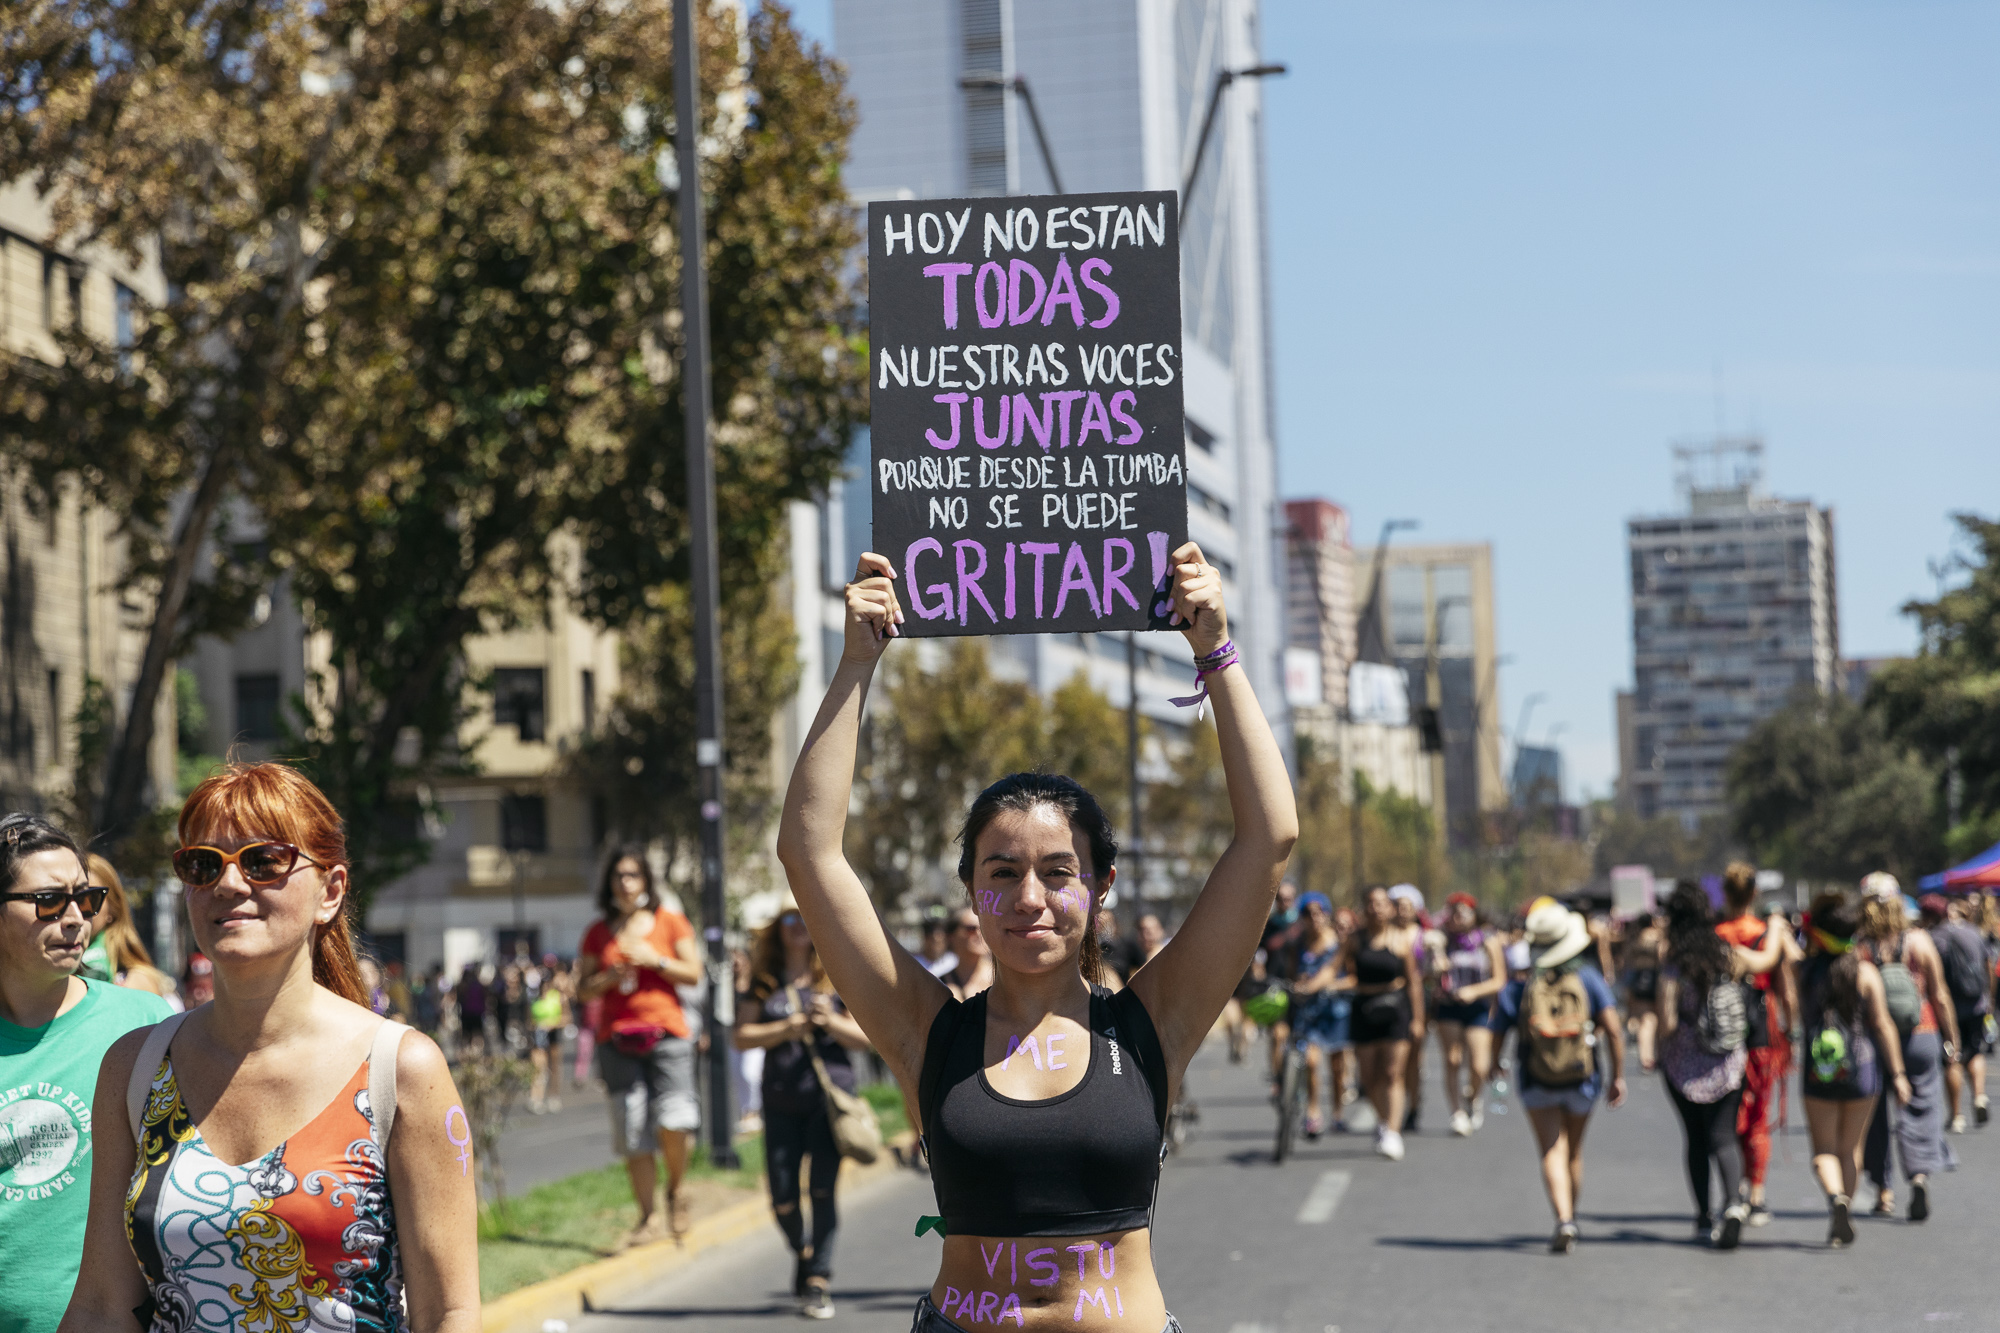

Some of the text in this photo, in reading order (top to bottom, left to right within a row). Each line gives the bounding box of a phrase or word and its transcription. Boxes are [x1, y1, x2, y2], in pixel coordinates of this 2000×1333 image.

[884, 201, 1165, 258] HOY NO ESTAN
[923, 252, 1121, 330] TODAS
[878, 343, 1175, 391] NUESTRAS VOCES
[925, 390, 1144, 453] JUNTAS
[878, 453, 1183, 494] PORQUE DESDE LA TUMBA
[929, 492, 1138, 530] NO SE PUEDE
[904, 530, 1170, 627] GRITAR!
[1000, 1033, 1068, 1072] ME
[1107, 1038, 1123, 1075] Reebok
[37, 1081, 63, 1099] UP
[61, 1090, 92, 1133] KIDS
[29, 1132, 70, 1142] OFFICIAL
[29, 1140, 65, 1150] CAMPER
[30, 1150, 54, 1160] 1997
[28, 1170, 76, 1201] BAND
[980, 1240, 1115, 1286] VISTO
[940, 1286, 1124, 1328] PARA MI
